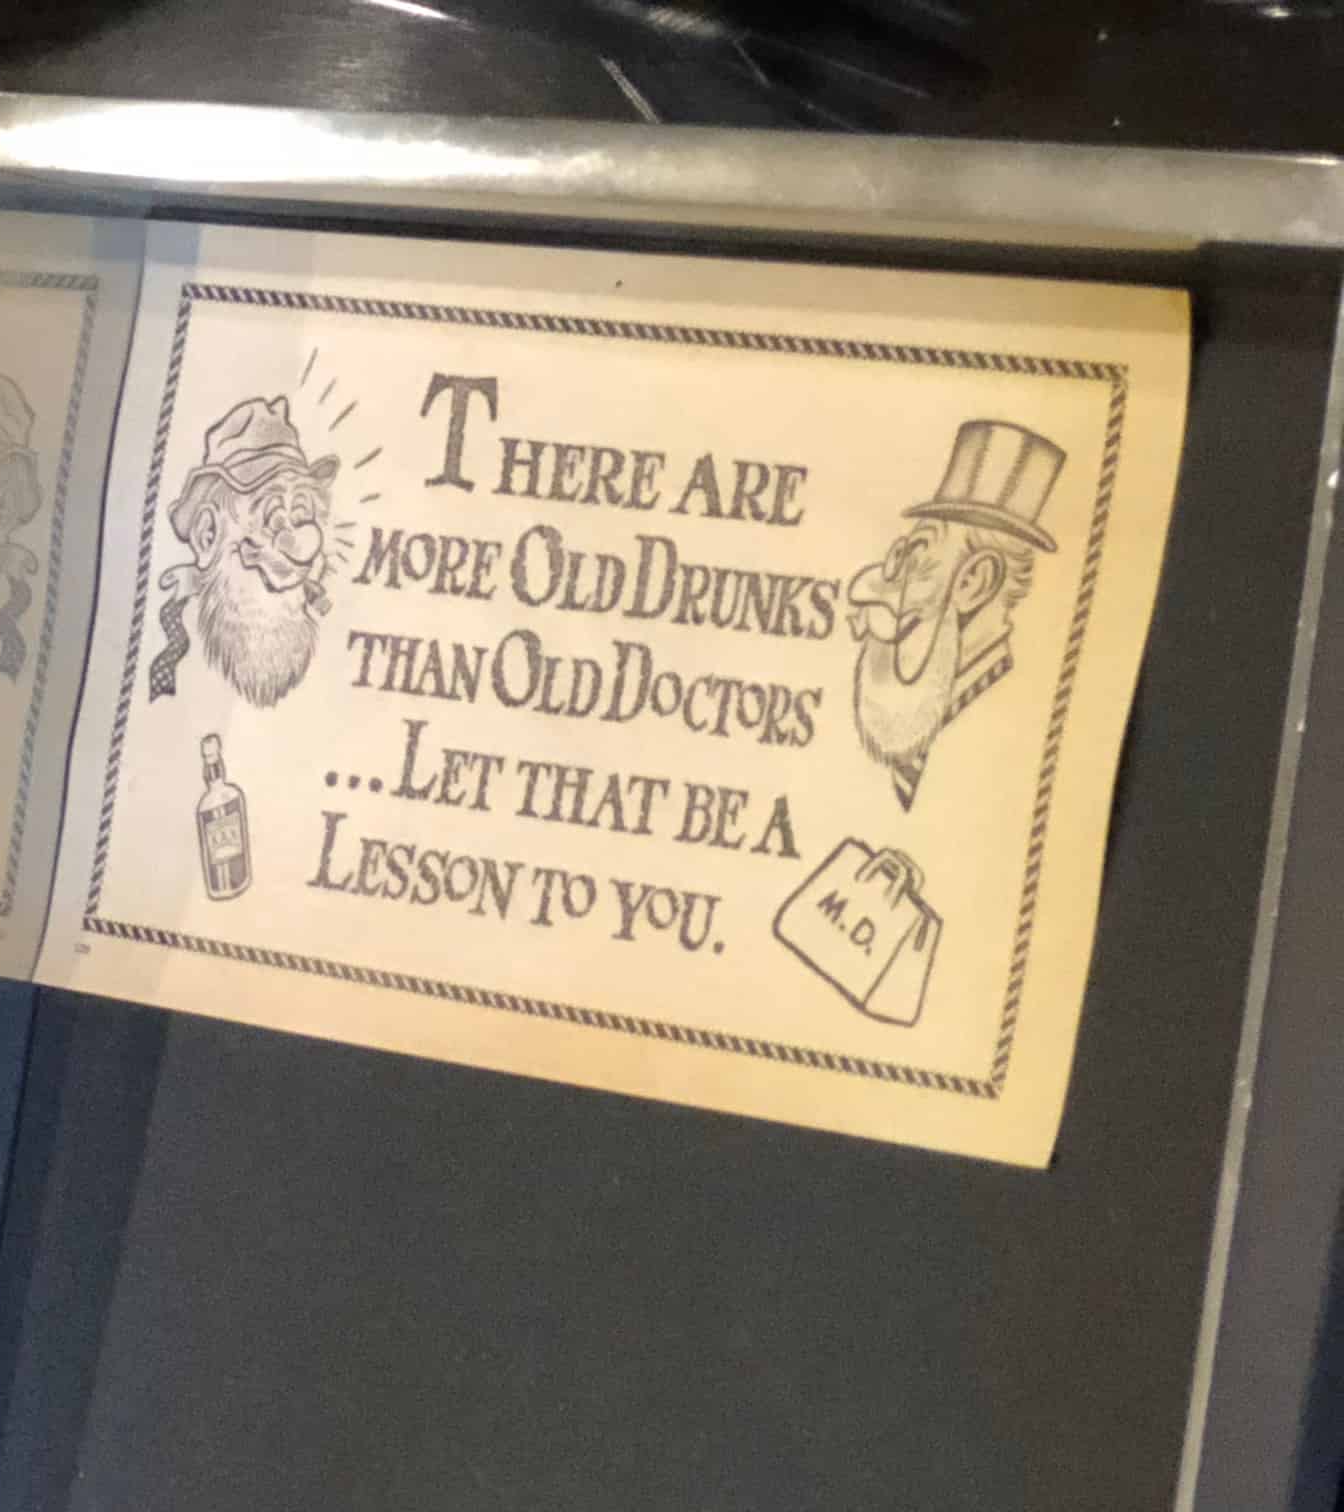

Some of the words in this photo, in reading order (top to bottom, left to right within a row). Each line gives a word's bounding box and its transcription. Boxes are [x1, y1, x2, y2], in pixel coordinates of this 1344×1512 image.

[420, 373, 665, 510] THERE
[669, 453, 808, 526] ARE
[352, 527, 502, 600] MORE
[511, 524, 627, 613] OLD
[623, 534, 840, 640] DRUNKS
[348, 630, 487, 703] THAN
[492, 629, 603, 719] OLD
[600, 640, 823, 747] DOCTORS
[516, 760, 669, 835] THAT
[675, 781, 748, 850] BE
[750, 795, 802, 859] A
[307, 811, 524, 919] LESSON
[531, 867, 596, 927] TO
[612, 879, 725, 955] YOU.
[816, 888, 875, 957] M.D.
